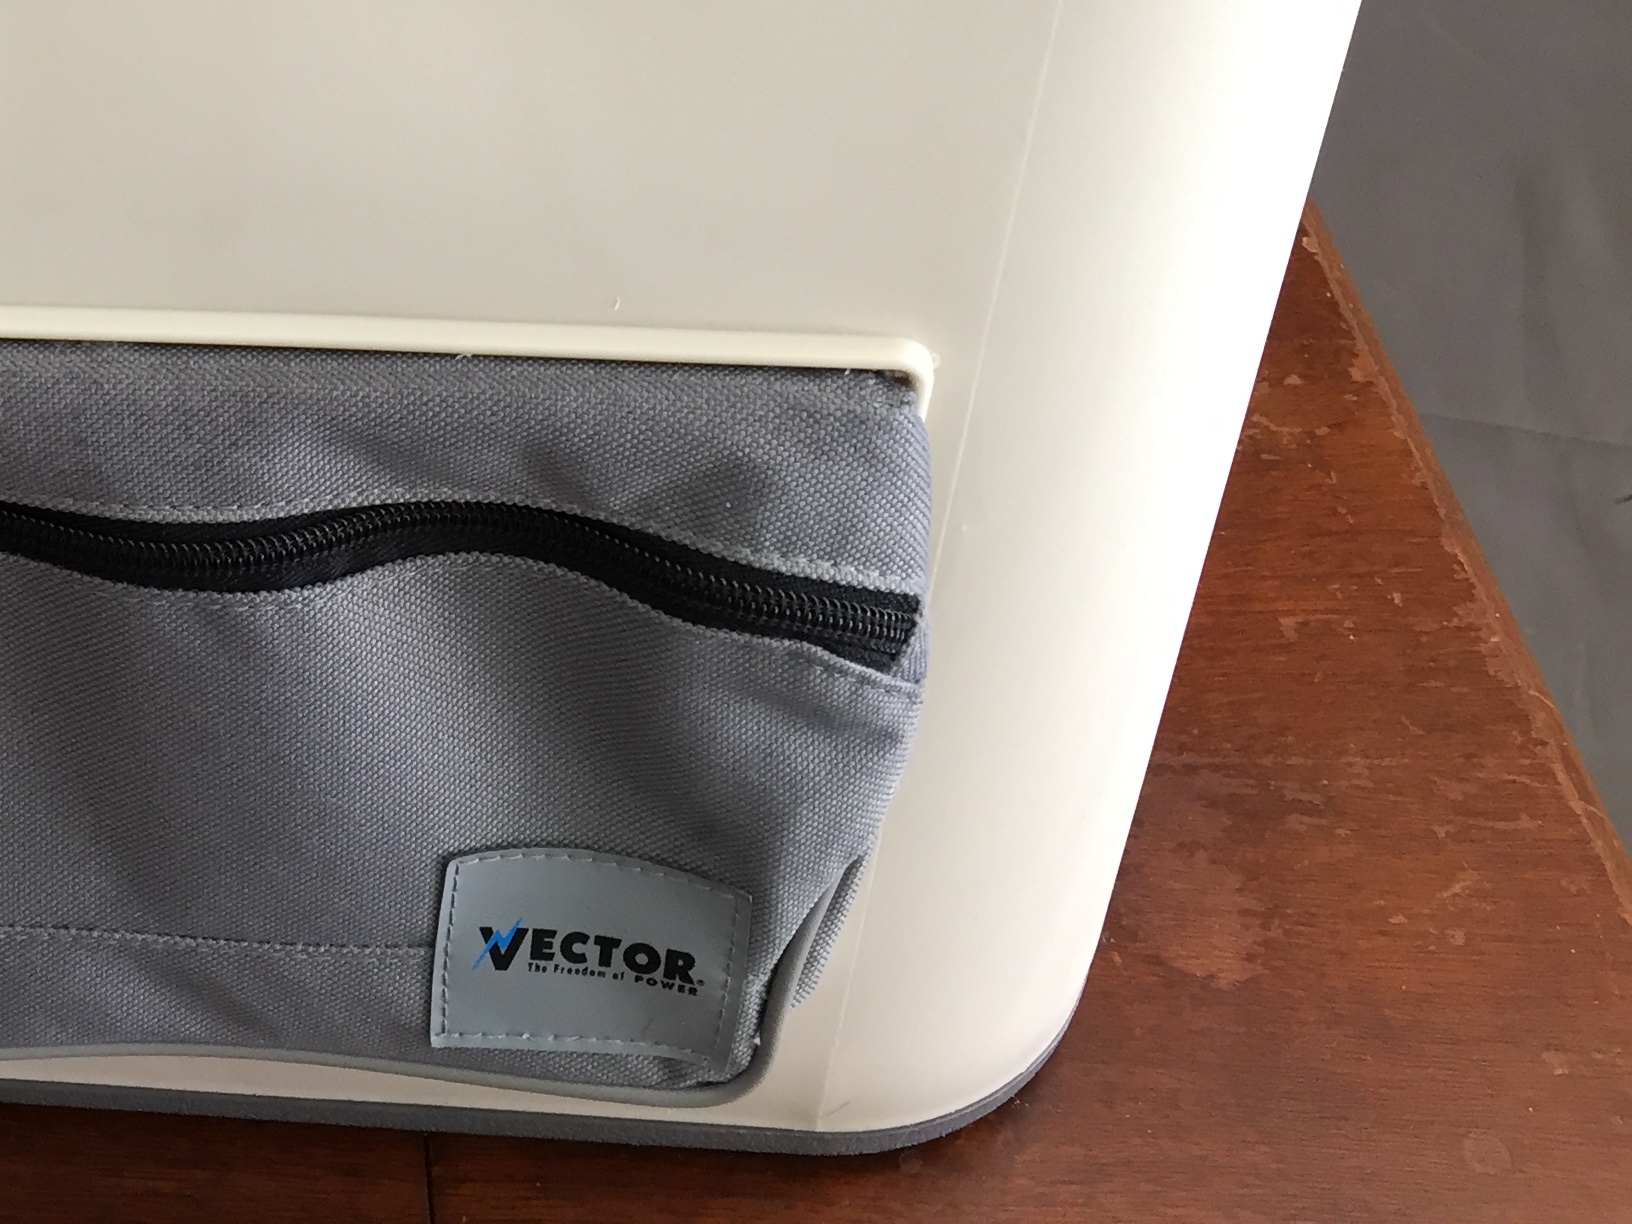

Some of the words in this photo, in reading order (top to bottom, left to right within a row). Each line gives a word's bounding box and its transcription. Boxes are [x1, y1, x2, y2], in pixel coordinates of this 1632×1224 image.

[477, 924, 697, 985] VECTOR
[527, 962, 547, 974] The
[553, 963, 607, 979] Freedom
[612, 971, 625, 981] of
[634, 974, 699, 997] POWER
